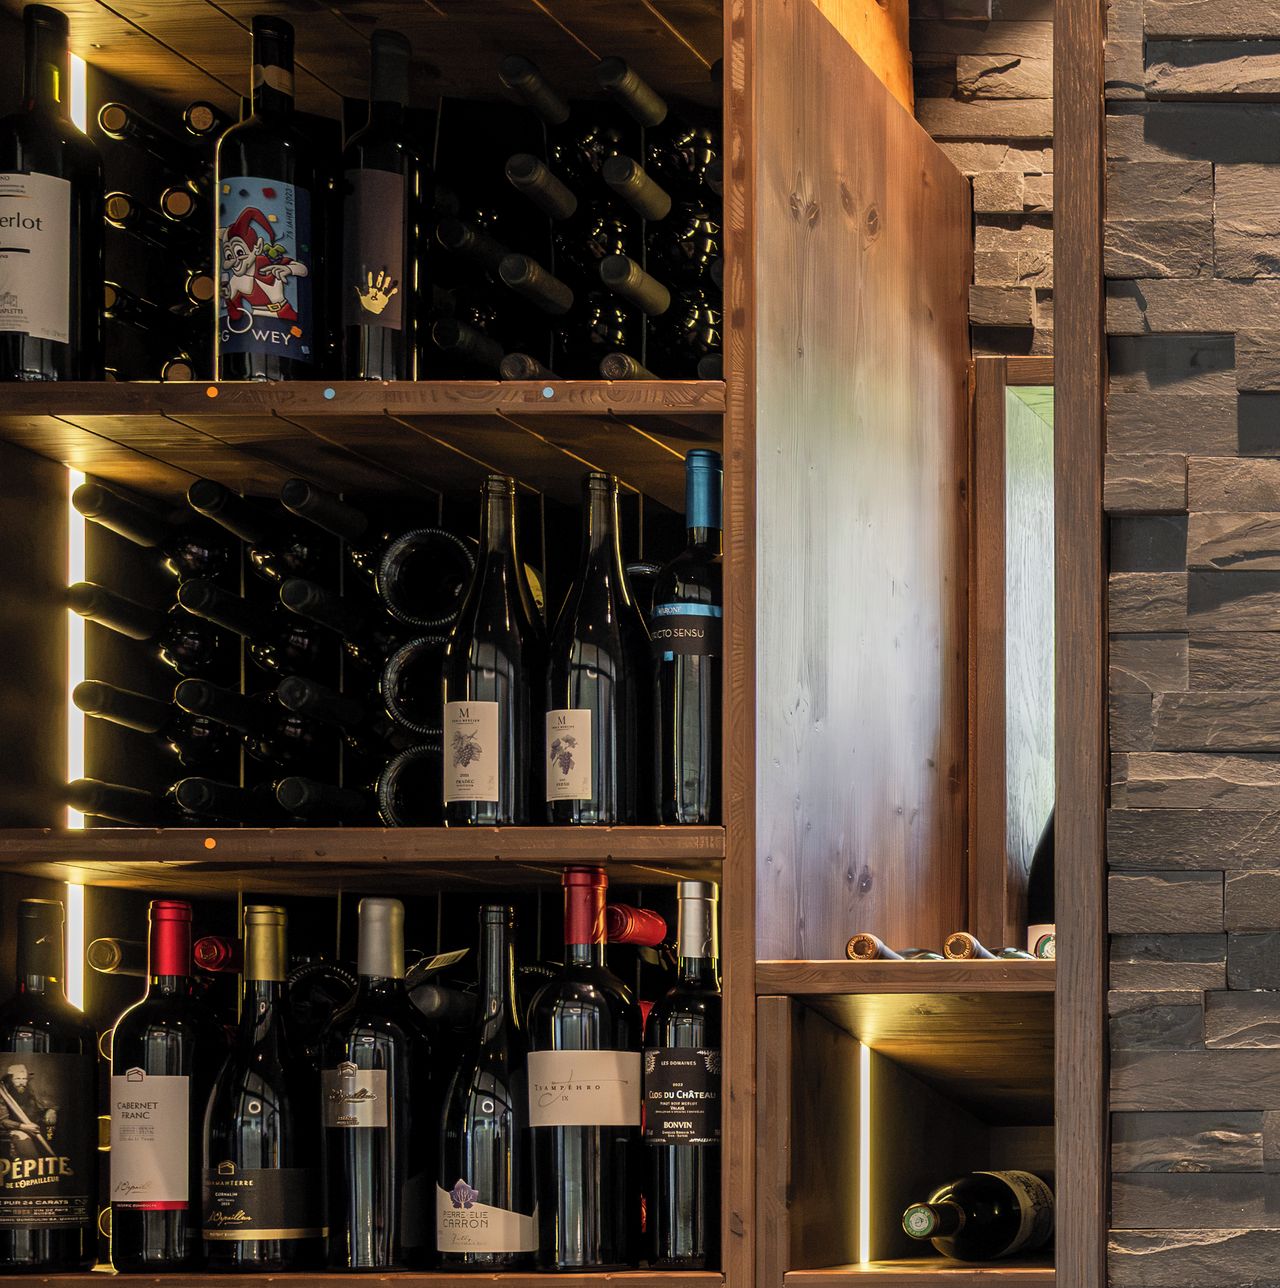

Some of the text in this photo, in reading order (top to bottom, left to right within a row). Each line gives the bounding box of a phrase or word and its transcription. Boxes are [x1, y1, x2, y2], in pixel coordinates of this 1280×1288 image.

[674, 628, 704, 638] SENSU
[649, 1090, 662, 1099] CLOS
[676, 1090, 717, 1099] CHÂTEAU
[116, 1102, 159, 1110] CABERNET
[121, 1112, 151, 1120] FRANC
[443, 1220, 488, 1228] CARRON
